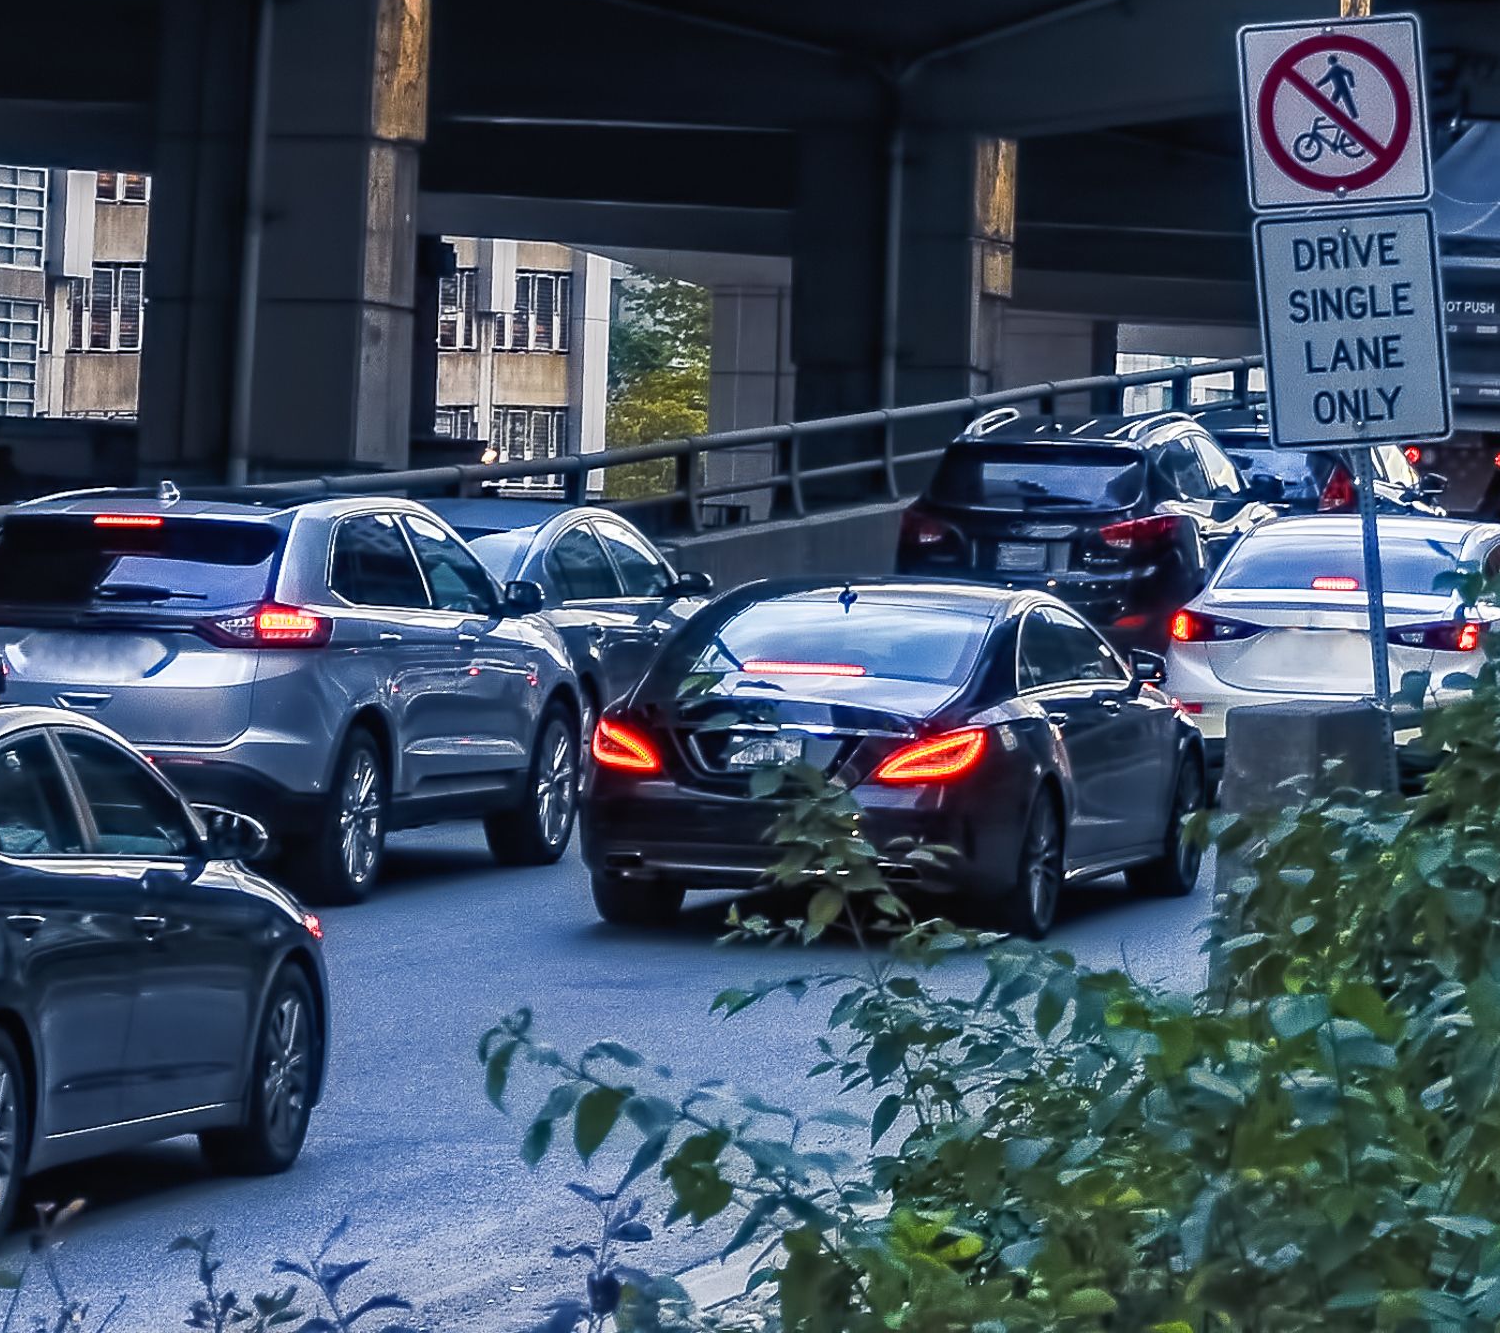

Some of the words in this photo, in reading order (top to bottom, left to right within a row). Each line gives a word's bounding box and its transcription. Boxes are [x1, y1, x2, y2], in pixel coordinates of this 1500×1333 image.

[1292, 232, 1400, 272] DRIVE
[1288, 283, 1415, 323] SINGLE
[1464, 302, 1495, 314] PUSH
[1304, 335, 1404, 373] LANE
[1312, 386, 1402, 424] ONLY
